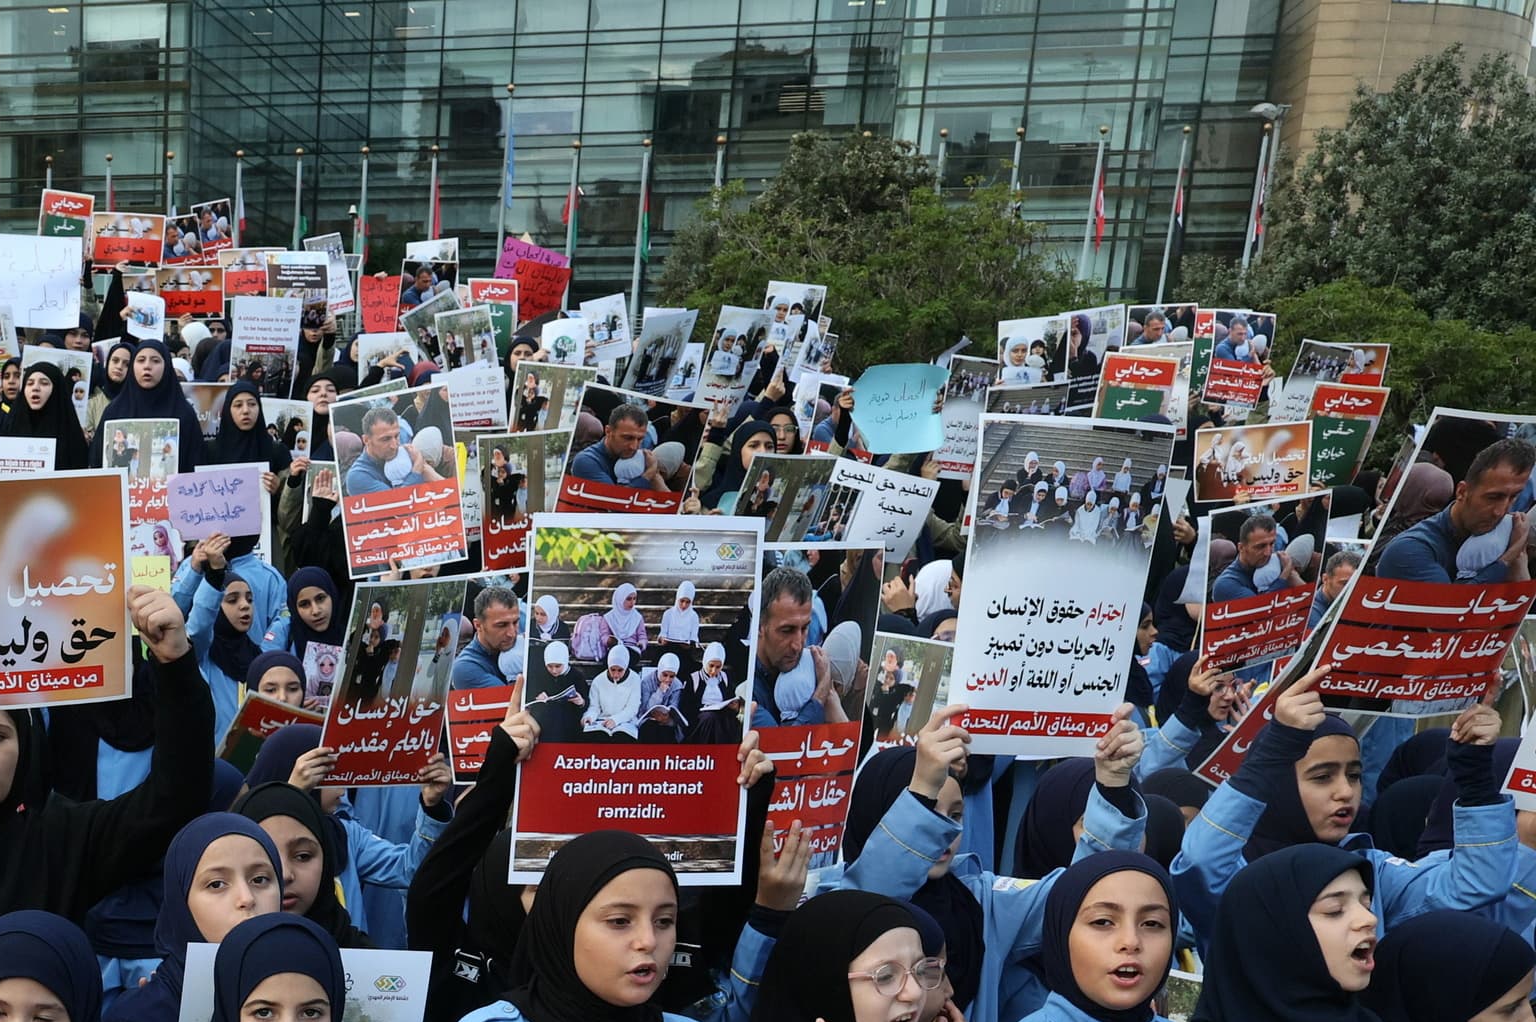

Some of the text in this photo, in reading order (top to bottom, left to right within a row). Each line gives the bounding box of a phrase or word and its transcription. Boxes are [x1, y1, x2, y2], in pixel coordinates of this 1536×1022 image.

[51, 197, 84, 210] حجابي
[1114, 362, 1163, 385] حجابي
[1324, 391, 1374, 410] حجابي
[1268, 449, 1305, 465] تحصيل
[1316, 445, 1346, 461] خياري
[836, 470, 933, 499] التعليم حق للجميع
[1246, 467, 1305, 485] حق وليس
[349, 484, 454, 515] حجابك
[567, 482, 676, 511] حجابك
[877, 497, 913, 517] محجبة
[351, 514, 457, 548] حقك الشخصي
[876, 523, 905, 538] وغير
[355, 540, 459, 564] من ميثاق الأمم المتحدة
[7, 562, 117, 607] تحصيل
[987, 595, 1127, 631] إحترام حقوق الإنسان
[1211, 590, 1311, 621] حجابك
[1361, 586, 1530, 621] حجابك
[59, 617, 117, 664] حق
[1025, 635, 1054, 658] دون
[1206, 614, 1306, 656] حقك الشخصي
[1057, 635, 1115, 661] والحريات
[1331, 634, 1506, 668] حقك الشخصي
[25, 674, 70, 693] ميثاق
[72, 673, 97, 688] من
[966, 661, 1121, 697] الجنس أو اللغة أو الدين
[1319, 677, 1487, 700] من ميثاق الأمم المتحدة
[337, 695, 441, 728] حق الإنسان
[961, 712, 1108, 735] من ميثاق الأمم المتحدة
[327, 728, 434, 762] بالعلم مقدس
[353, 767, 410, 784] ميثاق الأمم
[554, 755, 715, 773] Azərbaycanın hicablı
[563, 779, 703, 798] qadınları mətanət
[808, 779, 847, 811] حقك
[597, 803, 665, 820] rəmzidir.
